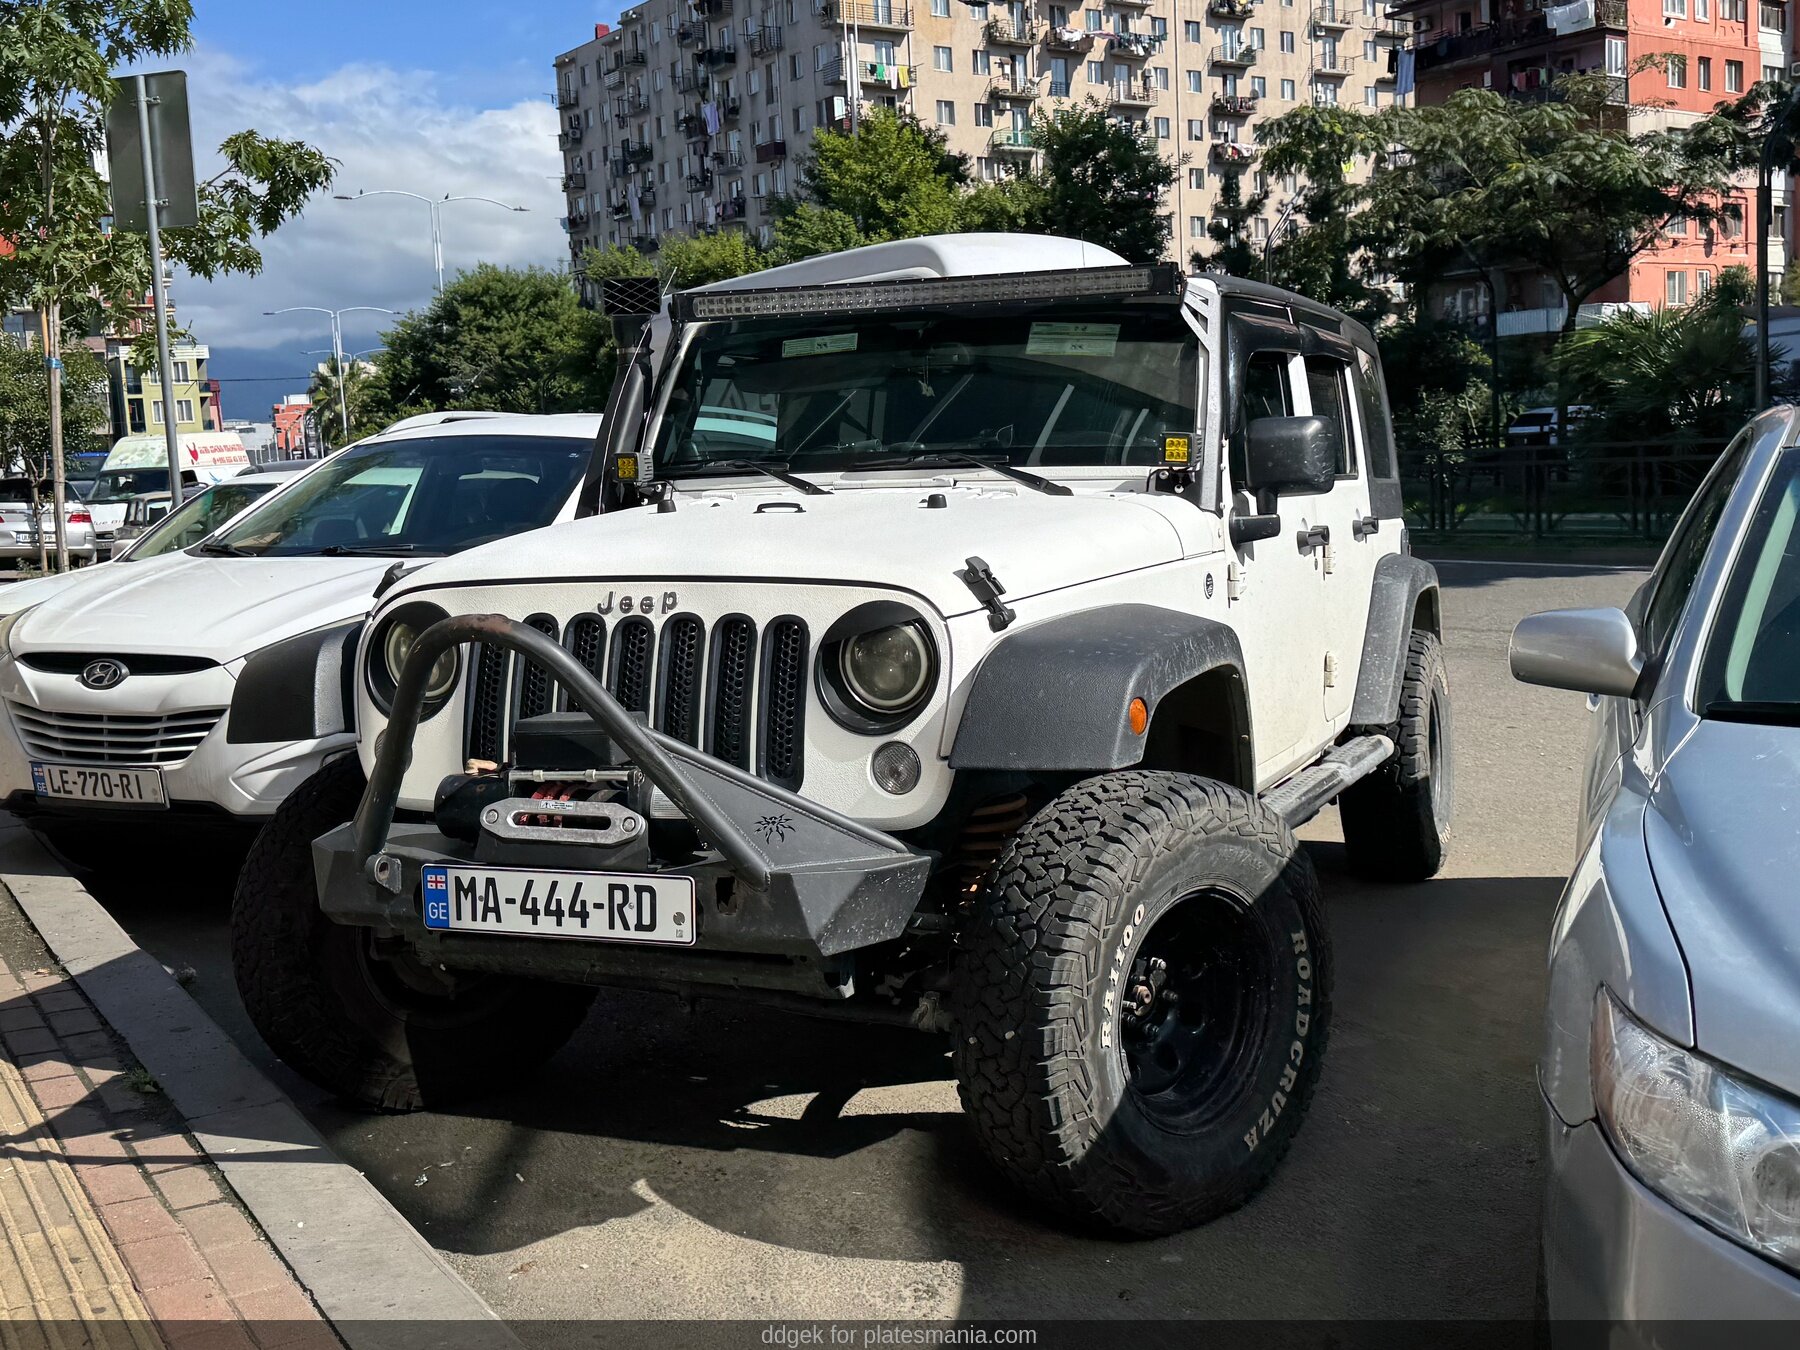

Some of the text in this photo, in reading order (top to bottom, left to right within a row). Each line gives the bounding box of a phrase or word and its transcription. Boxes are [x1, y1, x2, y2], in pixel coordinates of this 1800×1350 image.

[597, 591, 678, 615] Jeep
[37, 768, 143, 800] GE LE-770-RI
[428, 875, 657, 933] GE MA-444-RD
[1243, 929, 1312, 1152] ROADCRUZA
